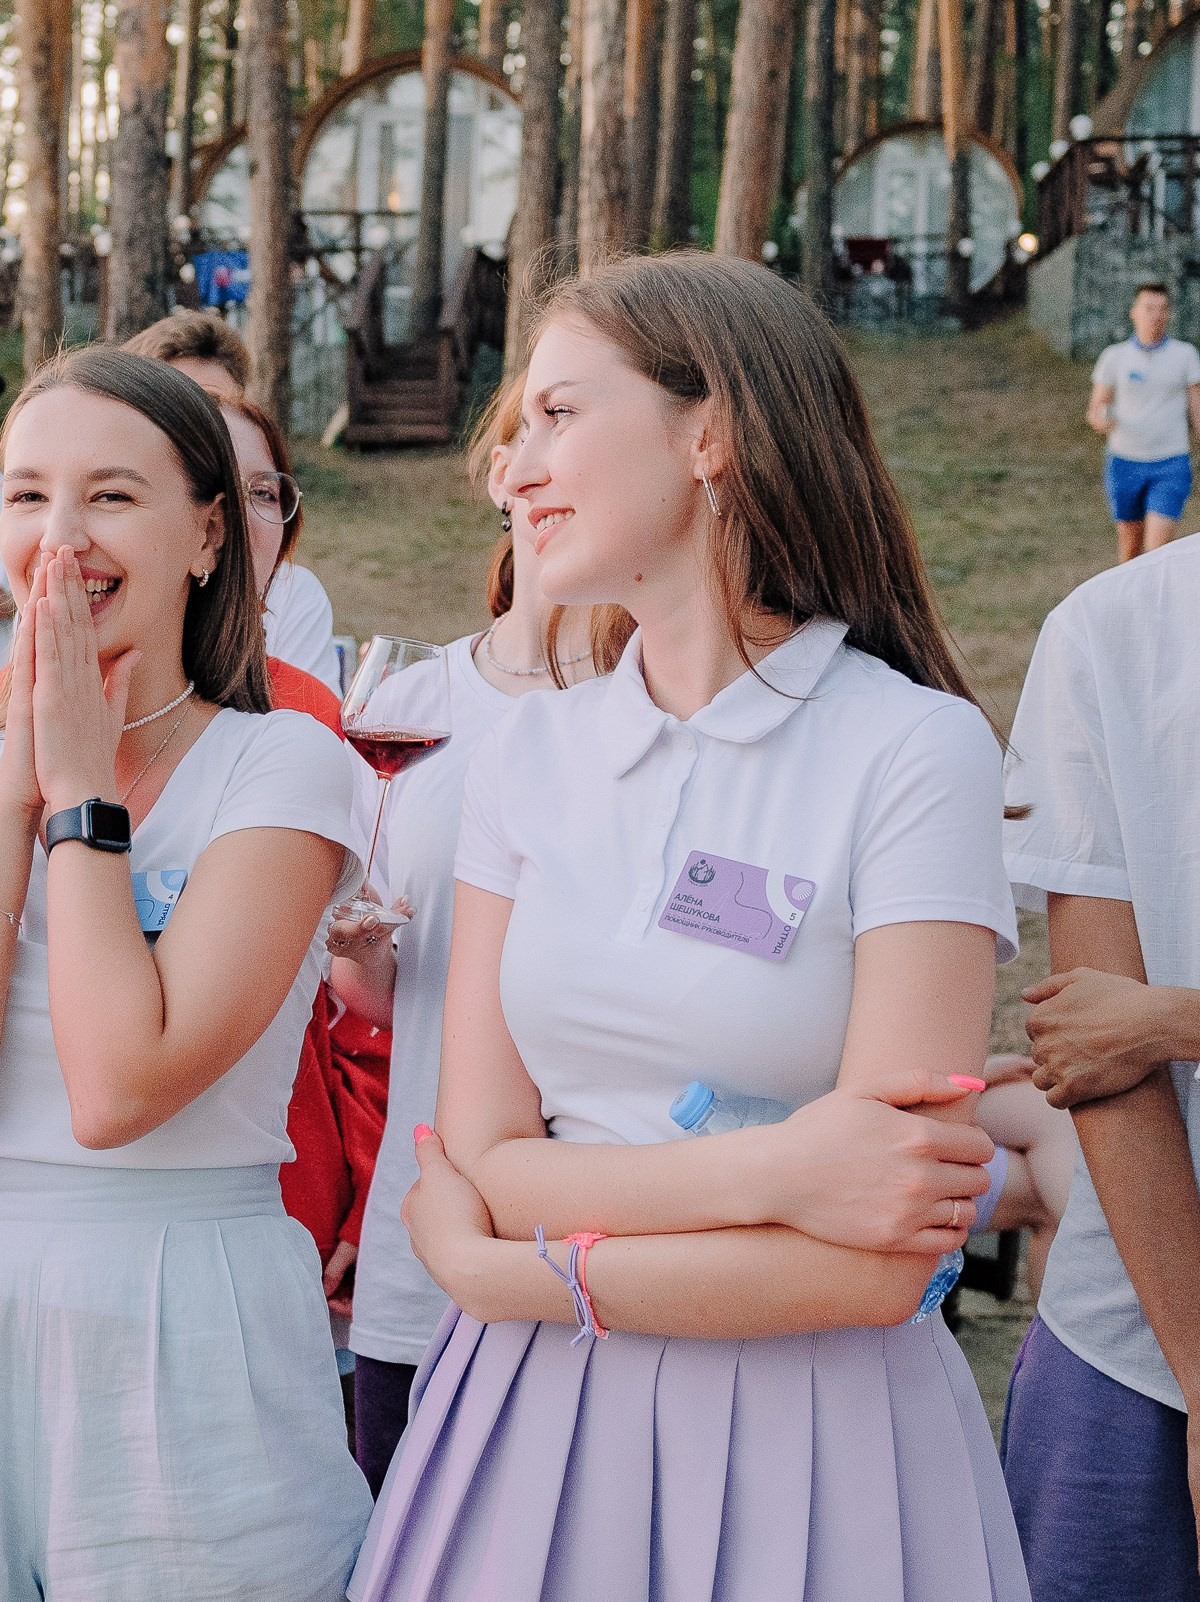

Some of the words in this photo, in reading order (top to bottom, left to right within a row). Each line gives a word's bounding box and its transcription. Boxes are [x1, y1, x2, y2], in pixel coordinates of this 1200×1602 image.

[674, 892, 704, 908] АЛЁНА
[157, 903, 171, 927] ОТРЯД
[669, 902, 721, 923] ШЕШУКОВА
[789, 912, 797, 921] 5
[664, 914, 700, 930] ПОМОЩНИК
[771, 925, 792, 955] ОТРЯД
